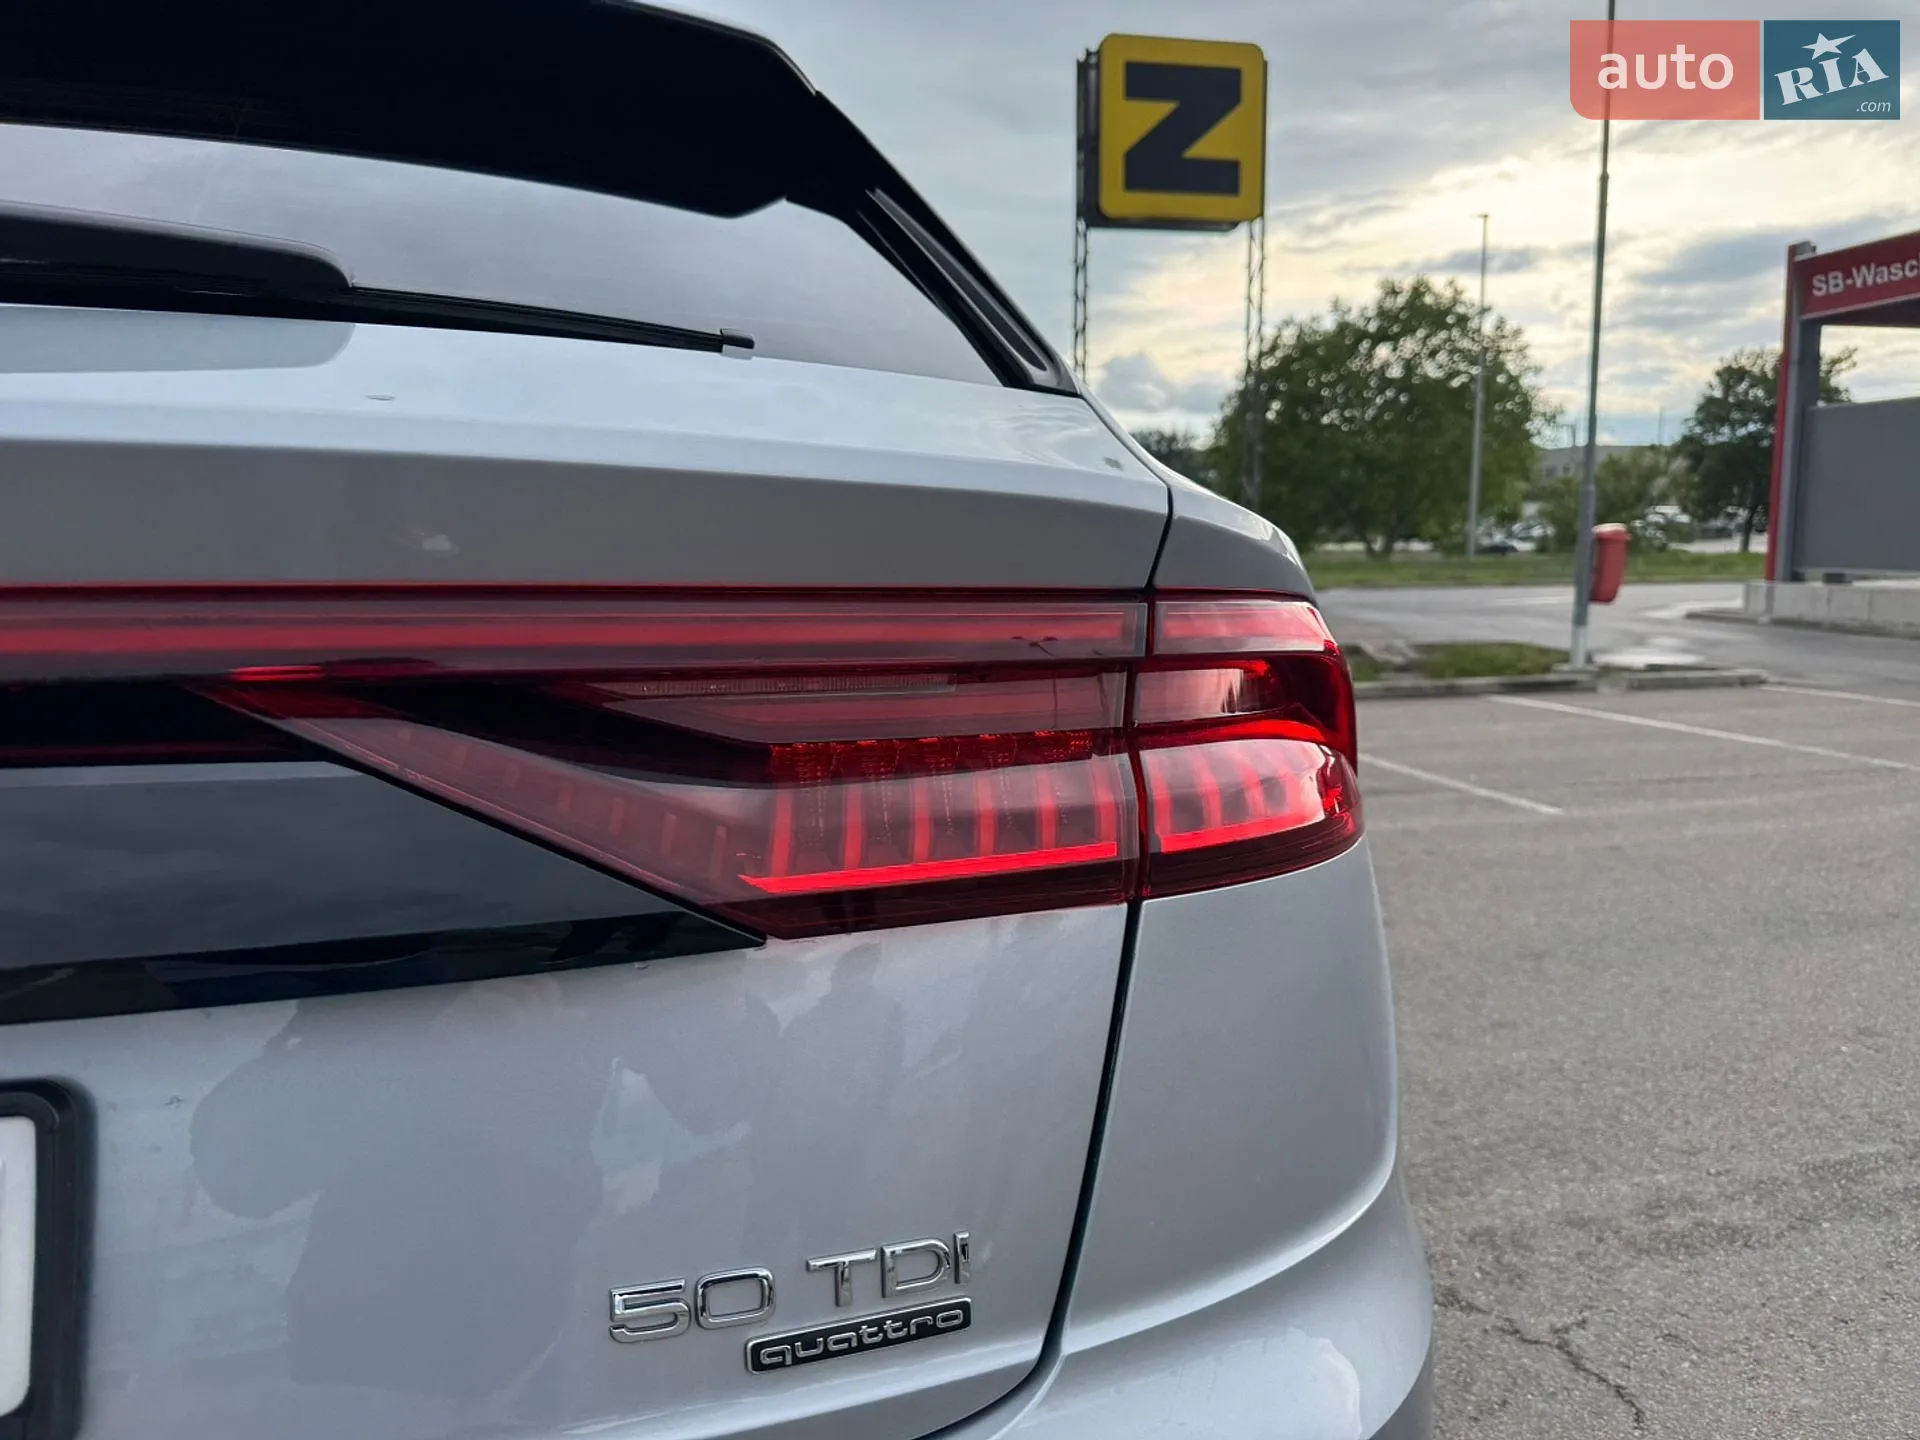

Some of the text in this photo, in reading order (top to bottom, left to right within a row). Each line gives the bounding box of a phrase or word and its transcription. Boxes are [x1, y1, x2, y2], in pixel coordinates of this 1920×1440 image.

[1124, 61, 1242, 197] Z
[1811, 250, 1920, 297] SB-Wasc
[609, 1230, 970, 1344] 50 TDI
[759, 1309, 964, 1366] quattro
